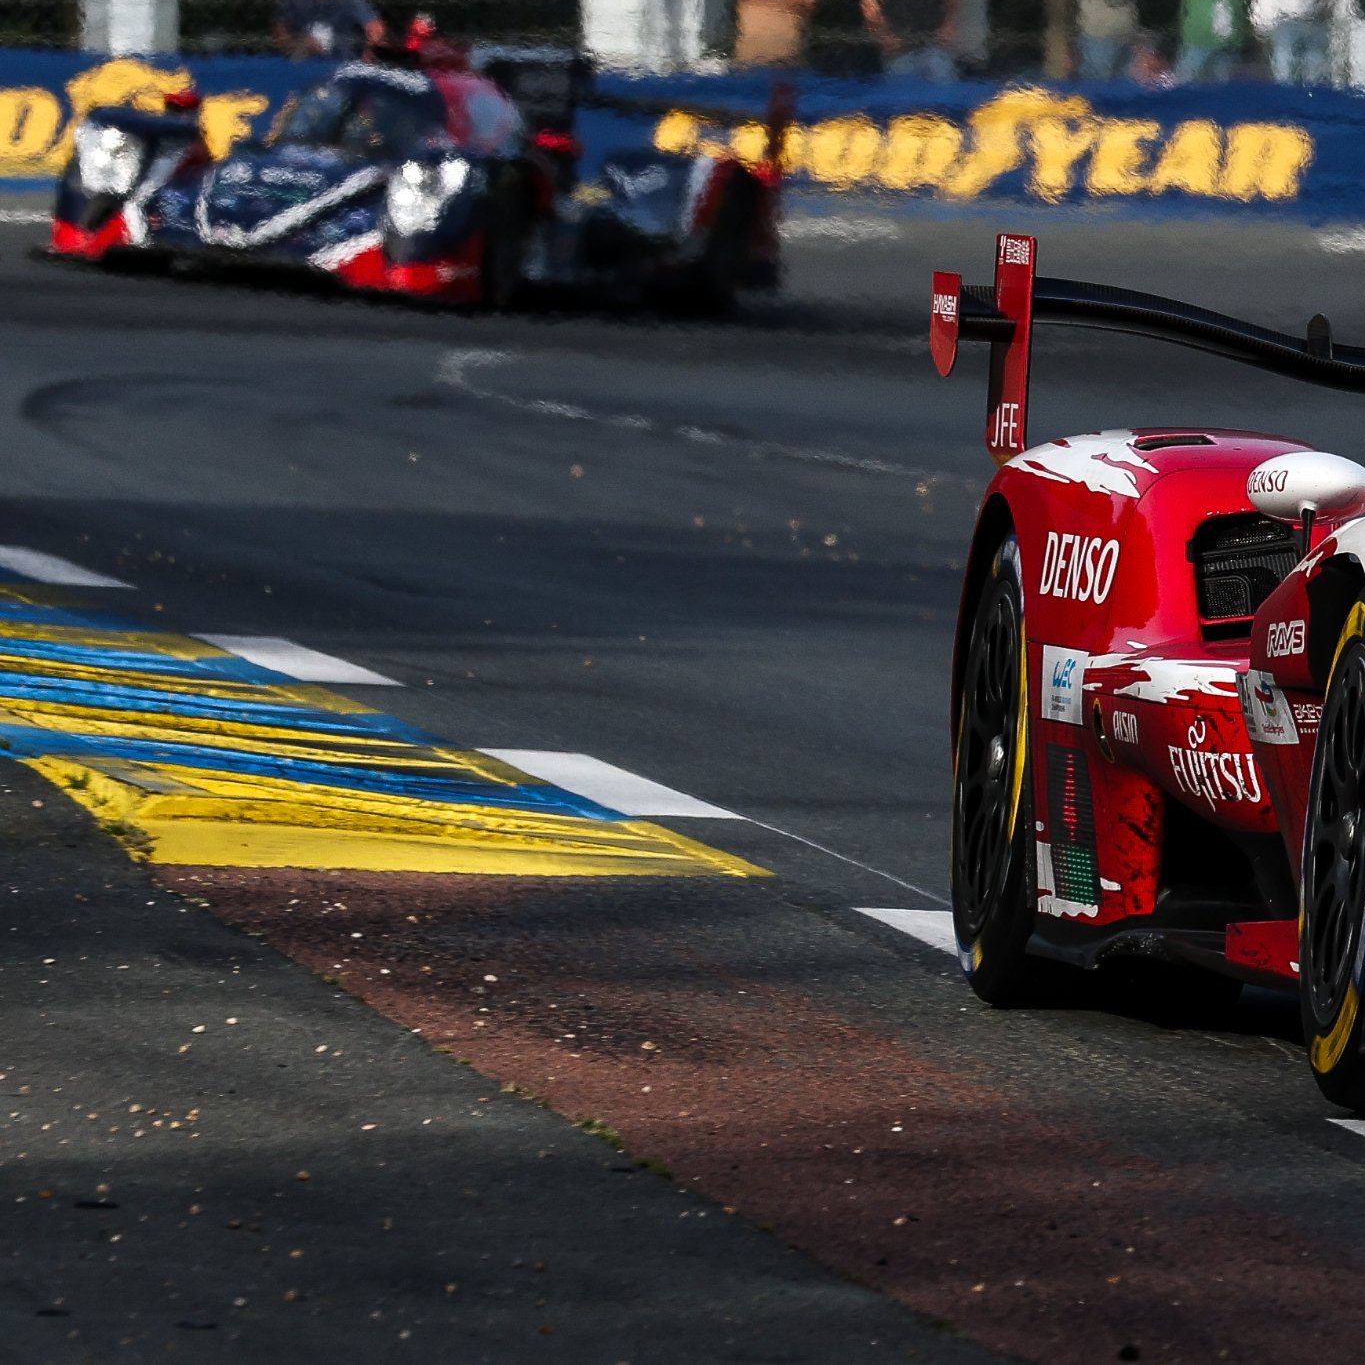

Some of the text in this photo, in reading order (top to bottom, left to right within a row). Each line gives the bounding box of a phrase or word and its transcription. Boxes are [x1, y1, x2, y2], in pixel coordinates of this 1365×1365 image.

[991, 403, 1019, 449] JFE
[1247, 469, 1289, 494] DENSO
[1039, 531, 1120, 605] DENSO
[1266, 619, 1306, 658] RAYS
[1112, 710, 1139, 745] AISIN
[1168, 744, 1261, 812] FUJITSU
